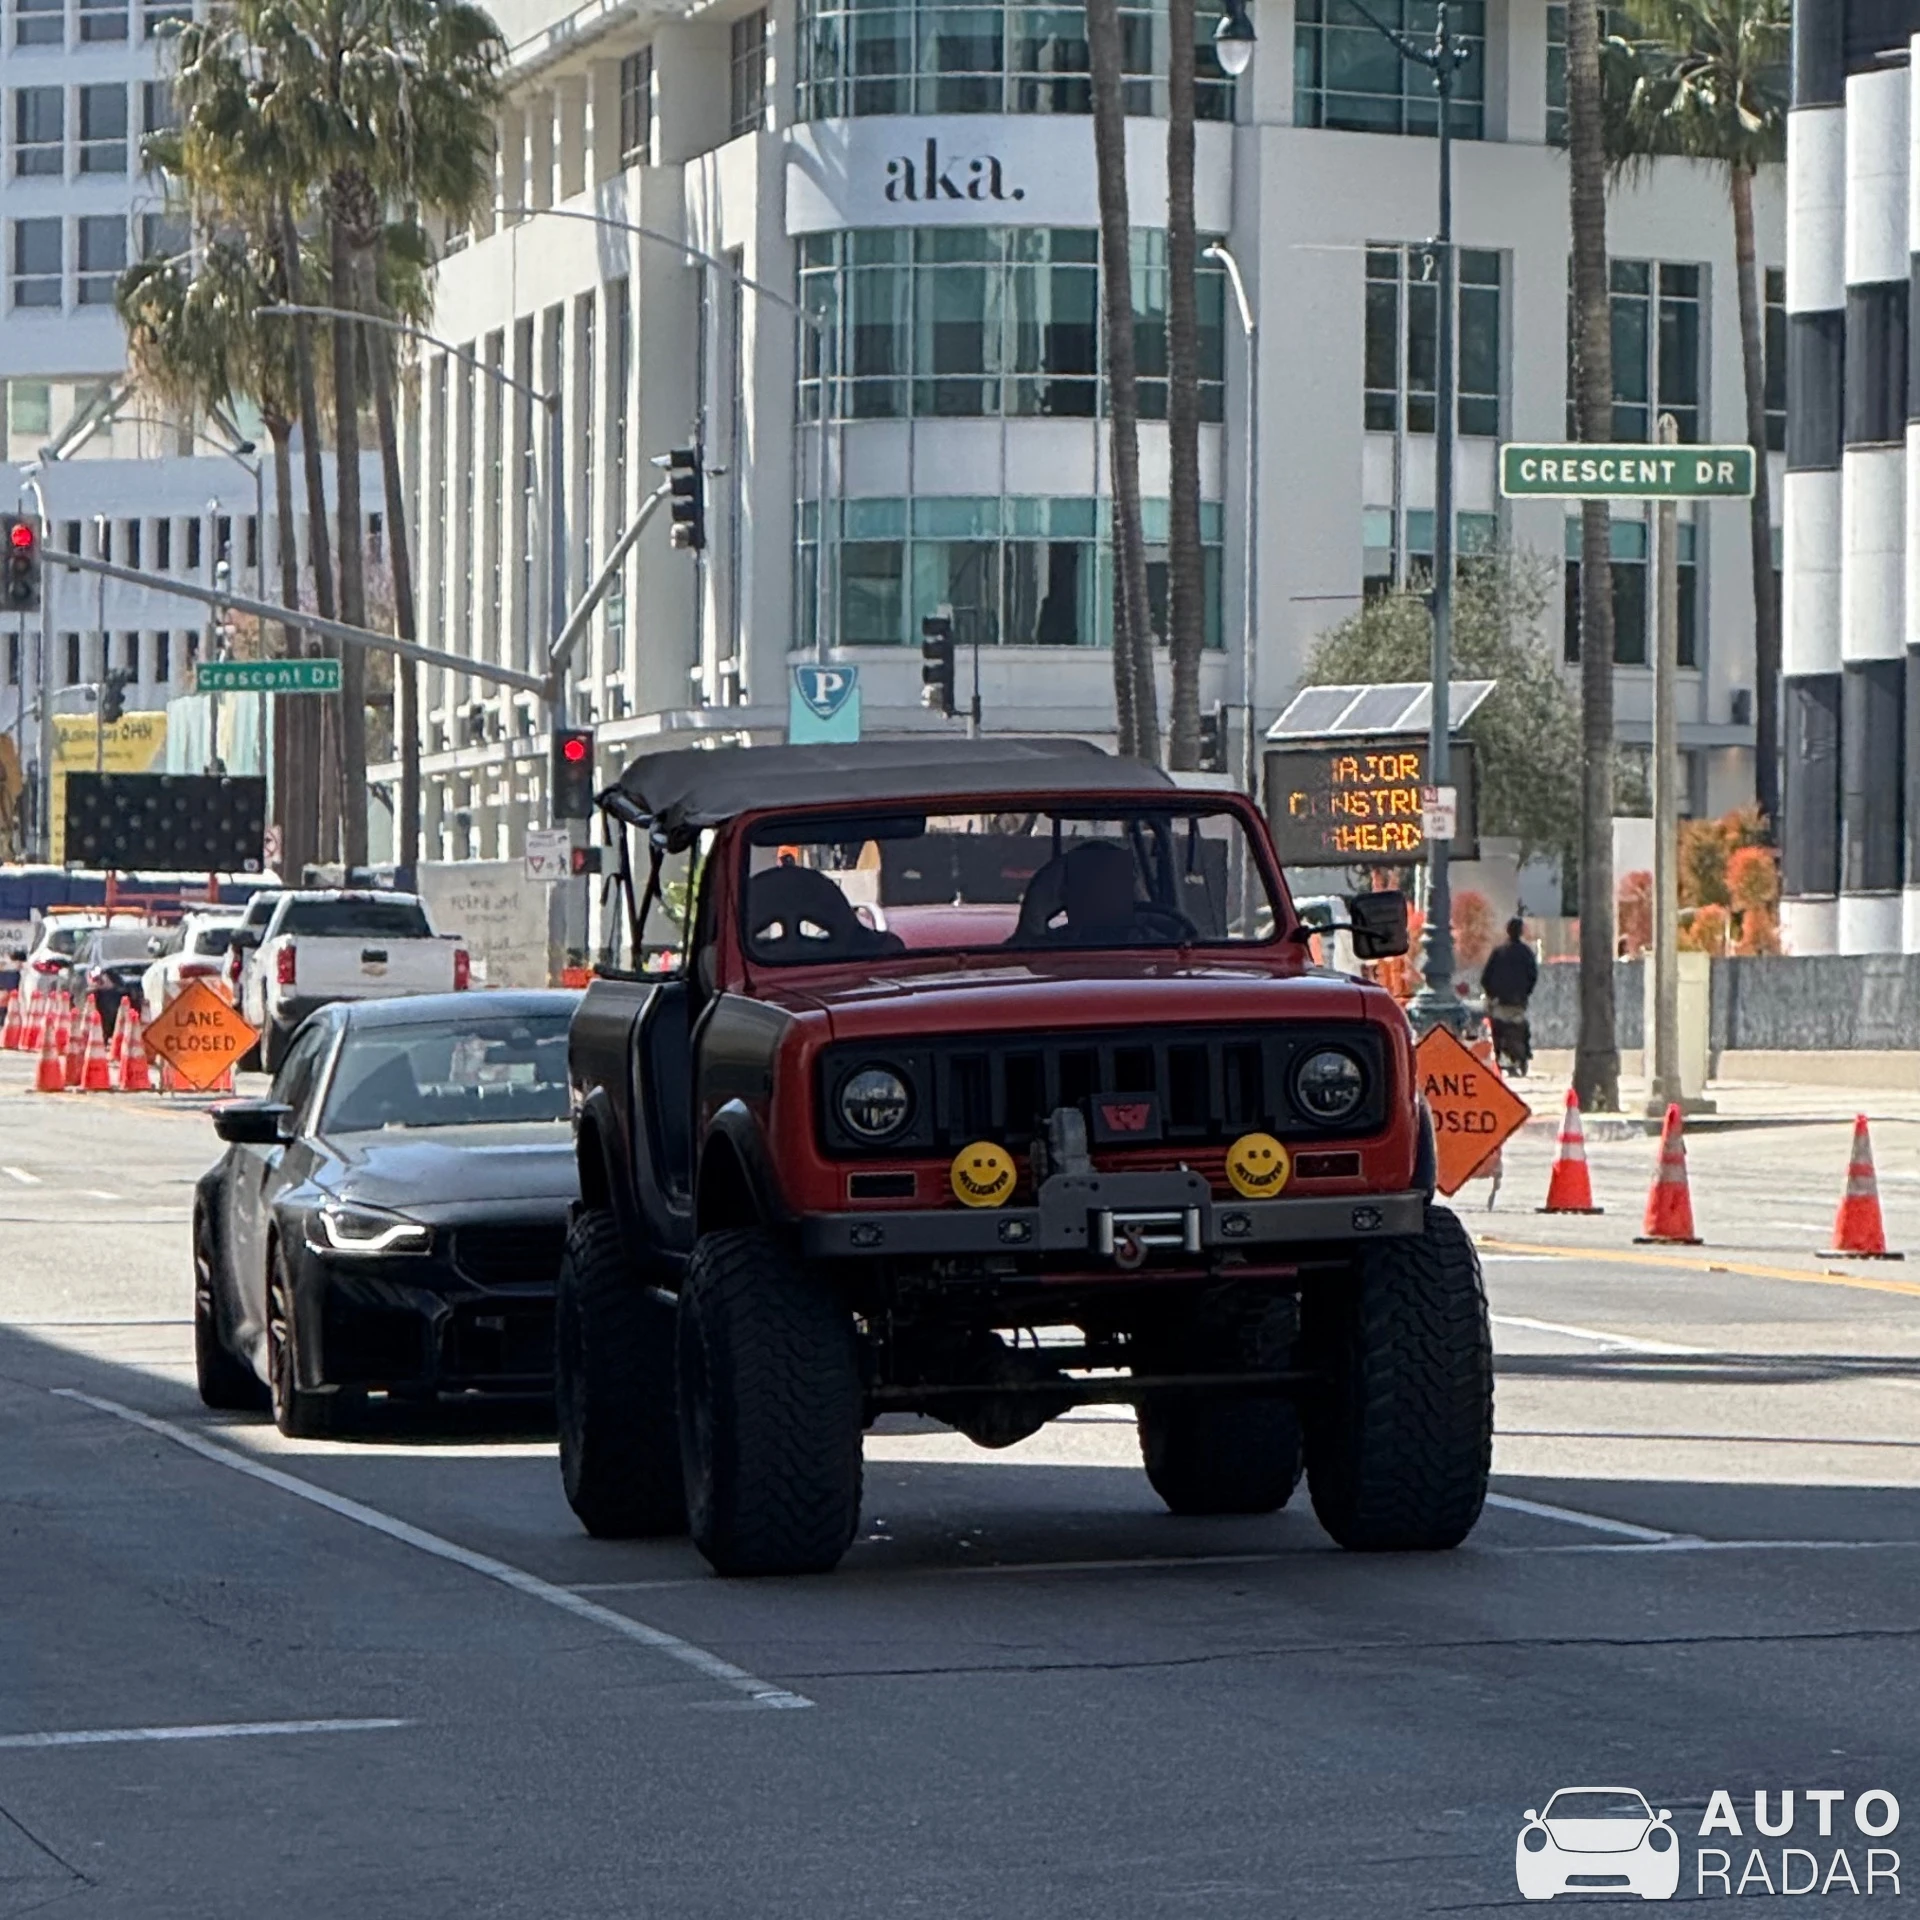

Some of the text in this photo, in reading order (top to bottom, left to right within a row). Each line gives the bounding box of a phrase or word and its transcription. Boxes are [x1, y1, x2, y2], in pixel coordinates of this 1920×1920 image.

[884, 137, 1025, 201] aka.
[1521, 459, 1734, 485] CRESCENT DR
[199, 667, 337, 685] Crescent Dr
[812, 672, 844, 703] P
[174, 1010, 225, 1028] LANE
[164, 1034, 237, 1052] CLOSED
[1424, 1073, 1478, 1097] ANE
[1431, 1110, 1498, 1134] OSED
